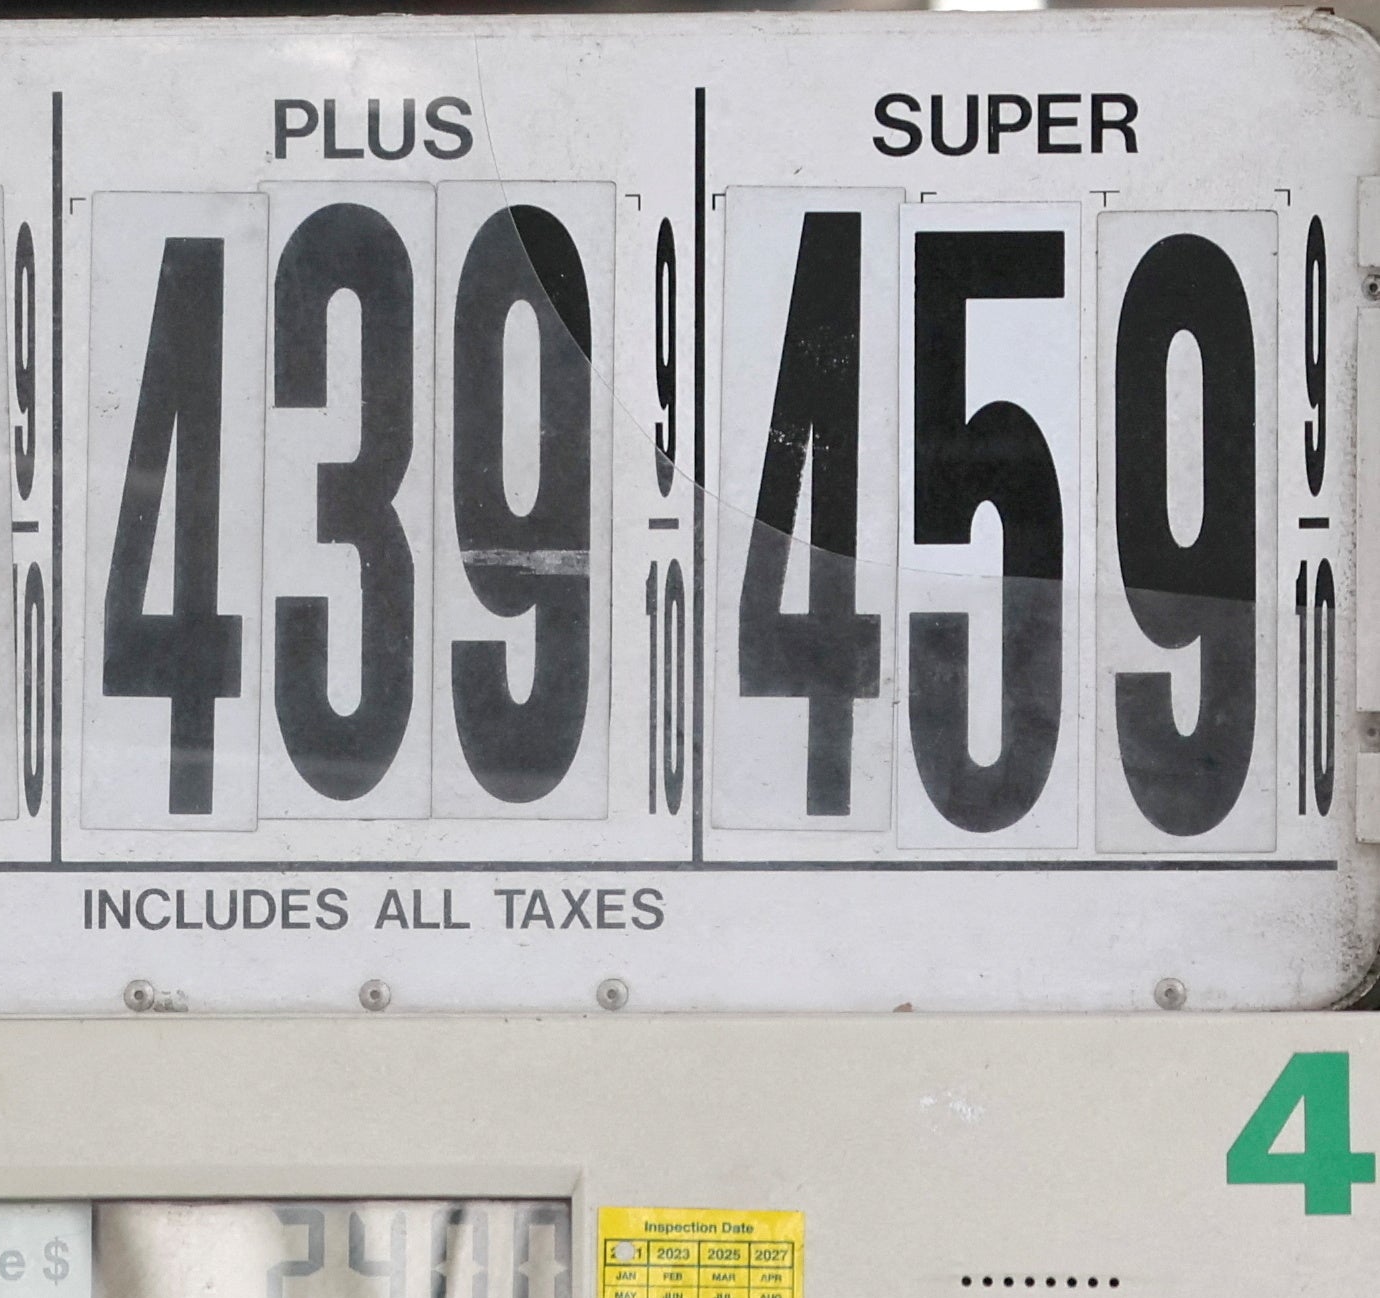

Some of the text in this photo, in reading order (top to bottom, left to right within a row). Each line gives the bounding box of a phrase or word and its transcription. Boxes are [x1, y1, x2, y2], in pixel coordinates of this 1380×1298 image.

[274, 97, 474, 161] PLUS
[872, 93, 1139, 157] SUPER
[82, 886, 665, 930] INCLUDES ALL TAXES
[1227, 1052, 1376, 1215] 4
[644, 1221, 754, 1235] Inspection Date
[43, 1237, 70, 1286] $
[657, 1248, 690, 1261] 2023
[708, 1249, 741, 1261] 2025
[755, 1249, 788, 1261] 2027
